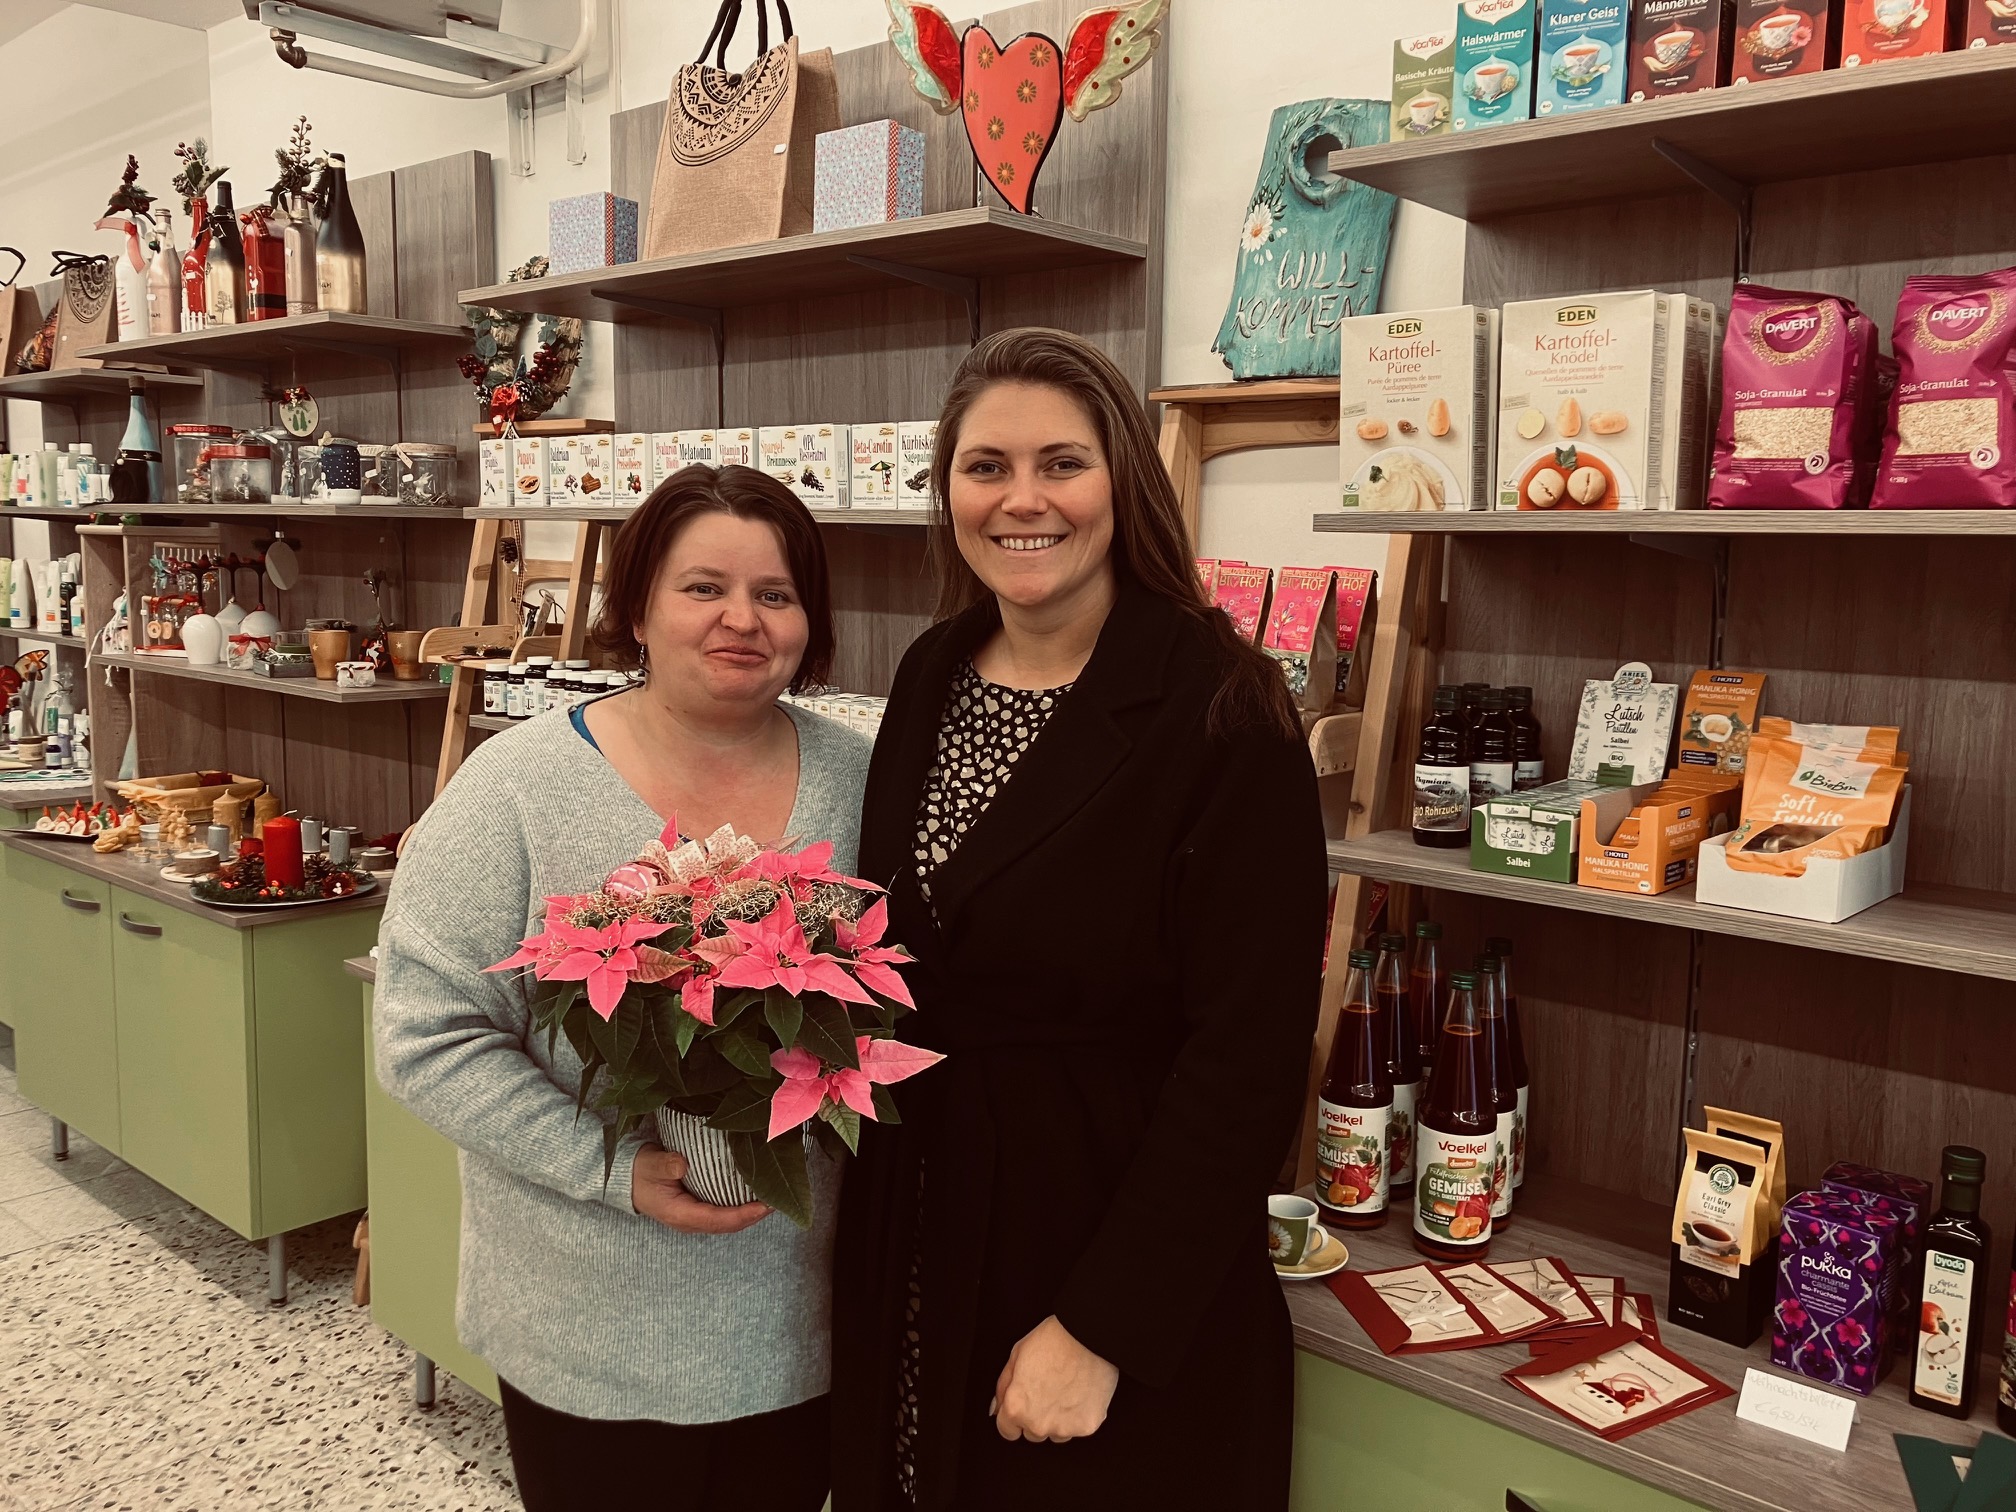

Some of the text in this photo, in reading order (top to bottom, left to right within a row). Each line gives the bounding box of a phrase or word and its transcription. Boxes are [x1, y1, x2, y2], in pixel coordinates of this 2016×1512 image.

[1475, 0, 1496, 14] YOGI
[1549, 12, 1586, 26] Klarer
[1588, 6, 1619, 20] Geist
[1409, 36, 1444, 51] YOGI TEA
[1461, 28, 1527, 47] Halswärmer
[1395, 69, 1427, 83] Basische
[1278, 250, 1376, 290] WILL-
[1230, 293, 1370, 343] KOMMEN
[1557, 309, 1596, 322] EDEN
[1931, 306, 1988, 321] DAVERT
[1388, 322, 1422, 335] EDEN
[1766, 317, 1817, 334] DAVERT
[1535, 329, 1618, 351] Kartoffel-
[1369, 340, 1442, 362] Kartoffel-
[1551, 348, 1598, 365] Knödel
[1387, 361, 1421, 374] Püree
[1900, 378, 1969, 394] Soja-Granulat
[1735, 388, 1808, 401] Soja-Granulat
[761, 439, 785, 456] Spargel-
[853, 438, 893, 453] Beta-Carotin
[517, 449, 535, 469] Papaya
[1296, 624, 1310, 633] Vital
[1339, 624, 1353, 632] Vital
[1692, 684, 1757, 696] MANUKA HONIG
[1604, 703, 1645, 722] Lutsch
[1606, 721, 1638, 734] Pastillen
[1416, 776, 1451, 785] Thymian-
[1779, 793, 1817, 814] Soft
[1501, 827, 1526, 840] Lutsch
[1506, 856, 1531, 868] Salbei
[1608, 851, 1629, 859] HOYER
[1584, 856, 1649, 872] MANUKA HONIG
[1592, 867, 1640, 878] HALSPASTILLEN
[1321, 1107, 1363, 1126] Voelkel
[1438, 1140, 1487, 1155] Voelkel
[1429, 1166, 1468, 1181] Feldfrisches
[1429, 1177, 1481, 1196] GEMÜSE
[1702, 1193, 1732, 1209] Earl Grey
[1703, 1201, 1727, 1215] Classic
[1935, 1254, 1965, 1271] byodo
[1801, 1269, 1850, 1290] charmante
[1811, 1279, 1838, 1293] cassis
[1937, 1278, 1959, 1289] Apfel
[1928, 1284, 1967, 1300] Balsam
